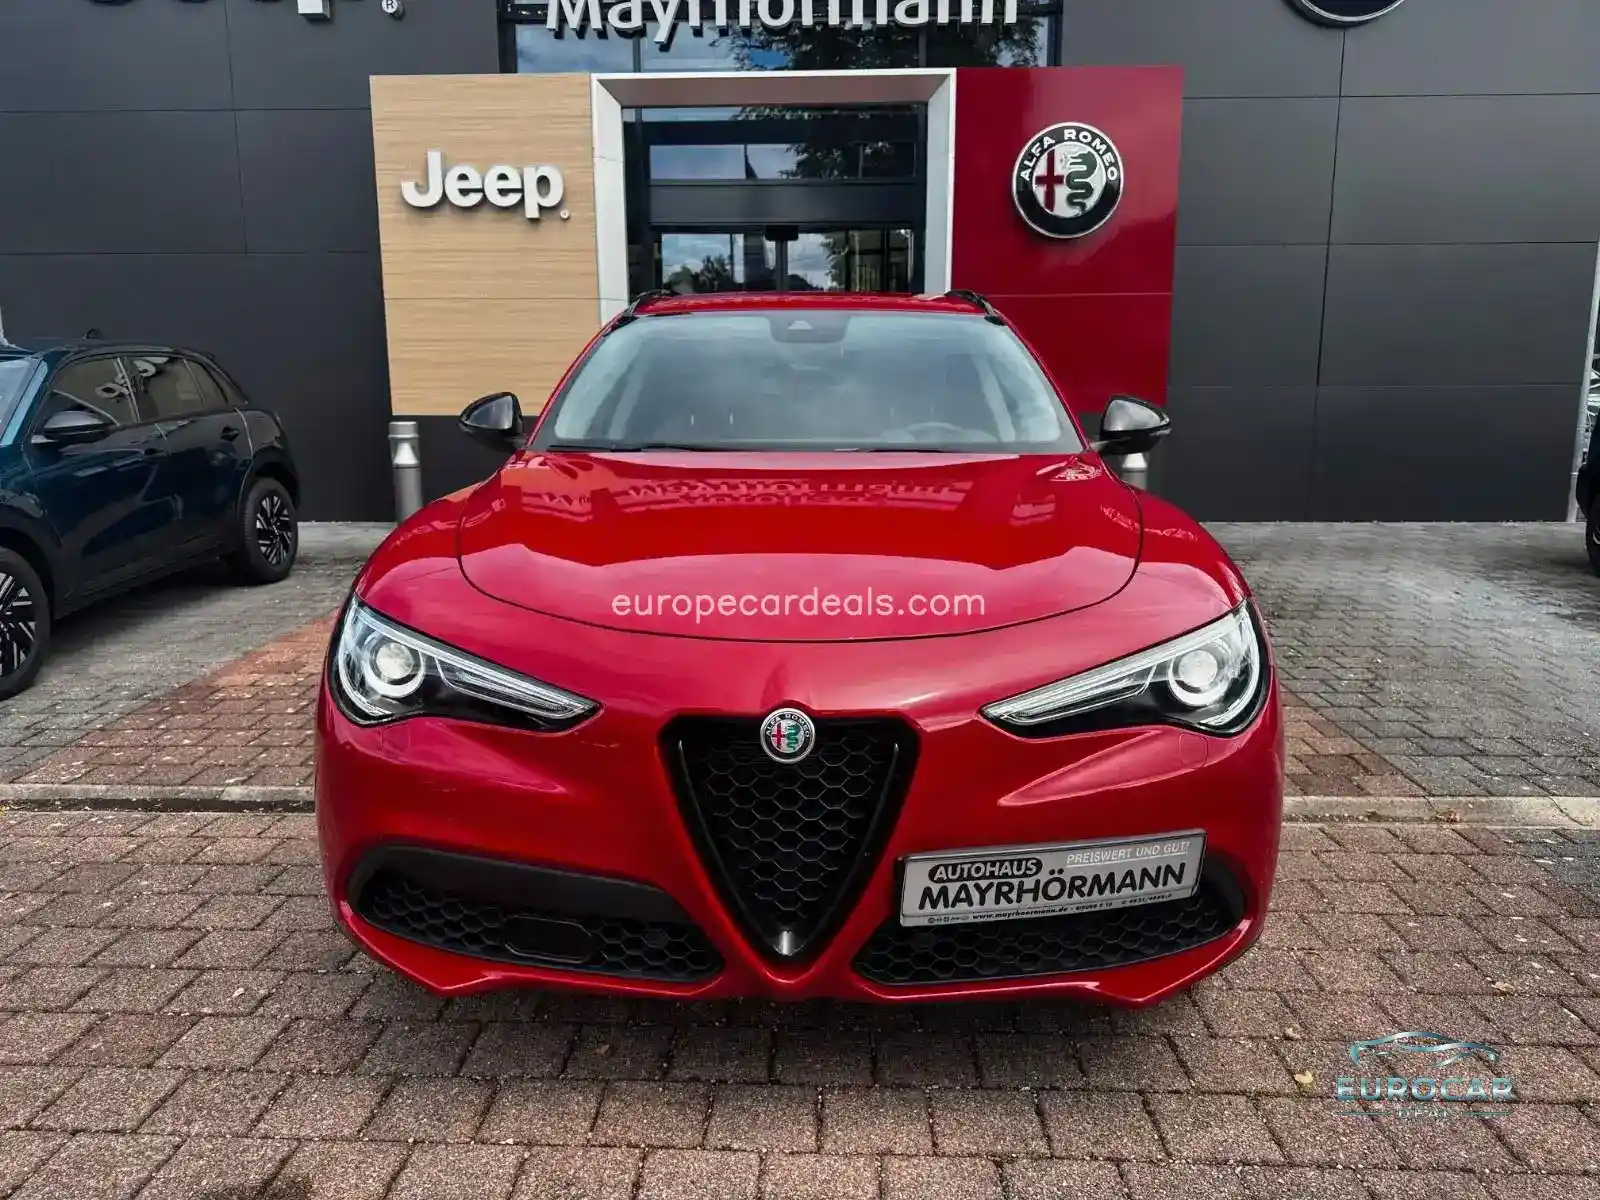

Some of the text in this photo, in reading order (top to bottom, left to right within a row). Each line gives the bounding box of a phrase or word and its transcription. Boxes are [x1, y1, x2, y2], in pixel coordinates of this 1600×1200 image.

[1020, 128, 1118, 182] ALFA ROMEO
[401, 150, 564, 219] Jeep
[765, 713, 810, 738] ALFA ROMEO
[933, 858, 1038, 881] AUTOHAUS
[1066, 848, 1132, 865] PREISWERT
[1135, 845, 1161, 857] UND
[918, 862, 1186, 911] MAYRHÖRMANN
